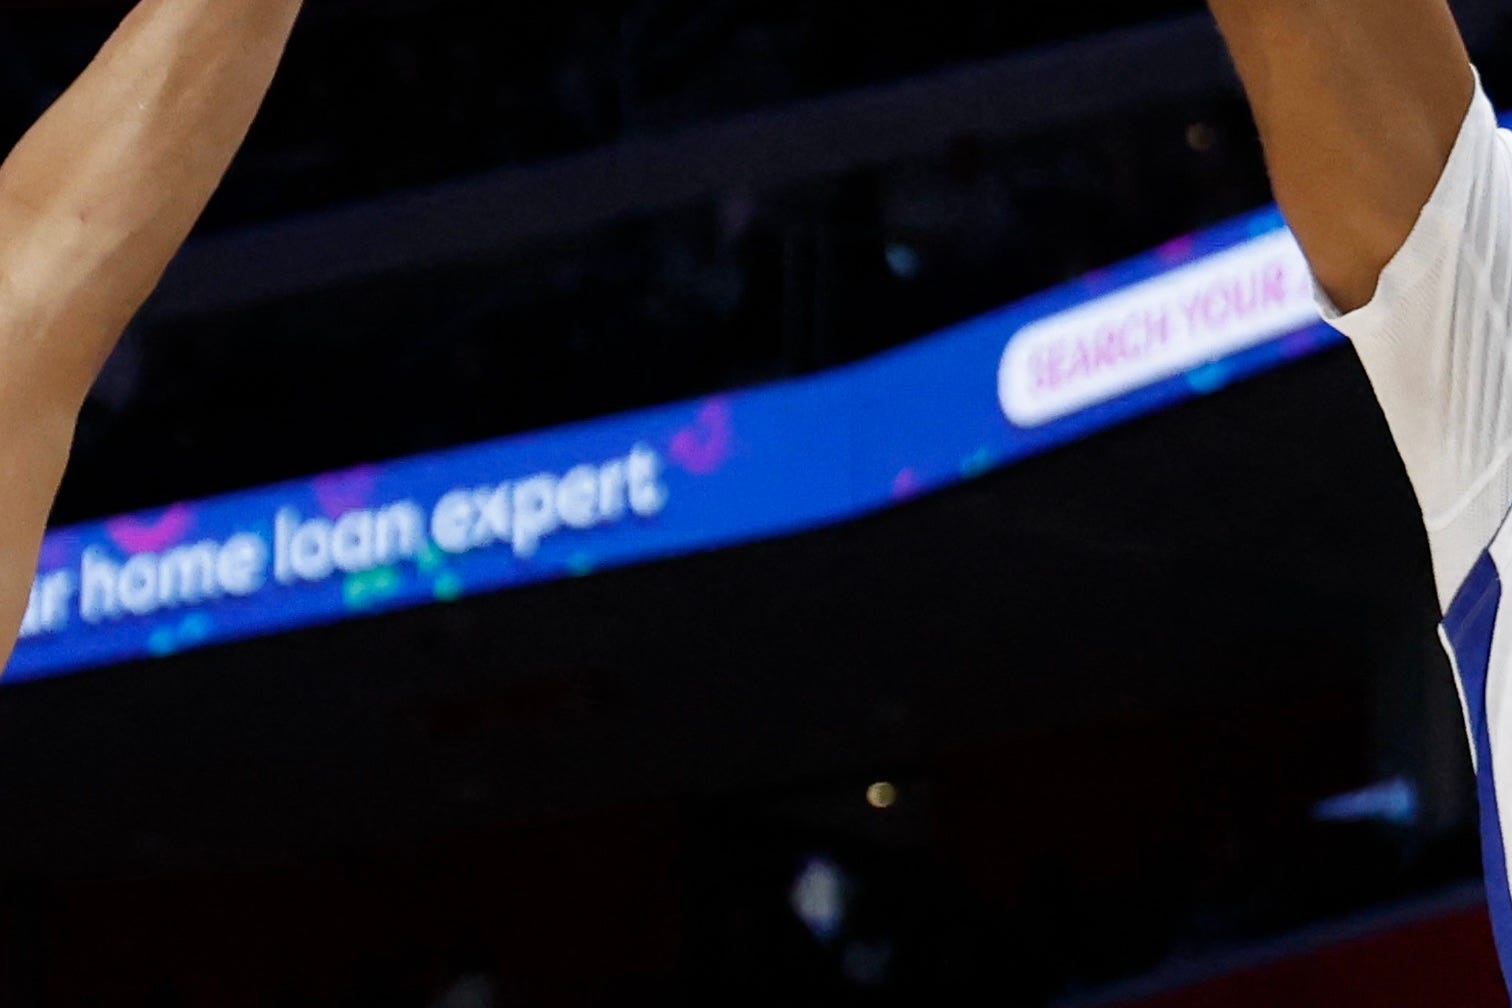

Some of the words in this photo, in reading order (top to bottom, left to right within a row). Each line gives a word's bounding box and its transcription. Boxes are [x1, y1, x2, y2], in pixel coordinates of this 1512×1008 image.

[1029, 302, 1169, 393] SEARCH
[1179, 262, 1287, 338] YOUR
[79, 530, 269, 624] home
[274, 498, 426, 585] loan
[432, 441, 667, 559] expert
